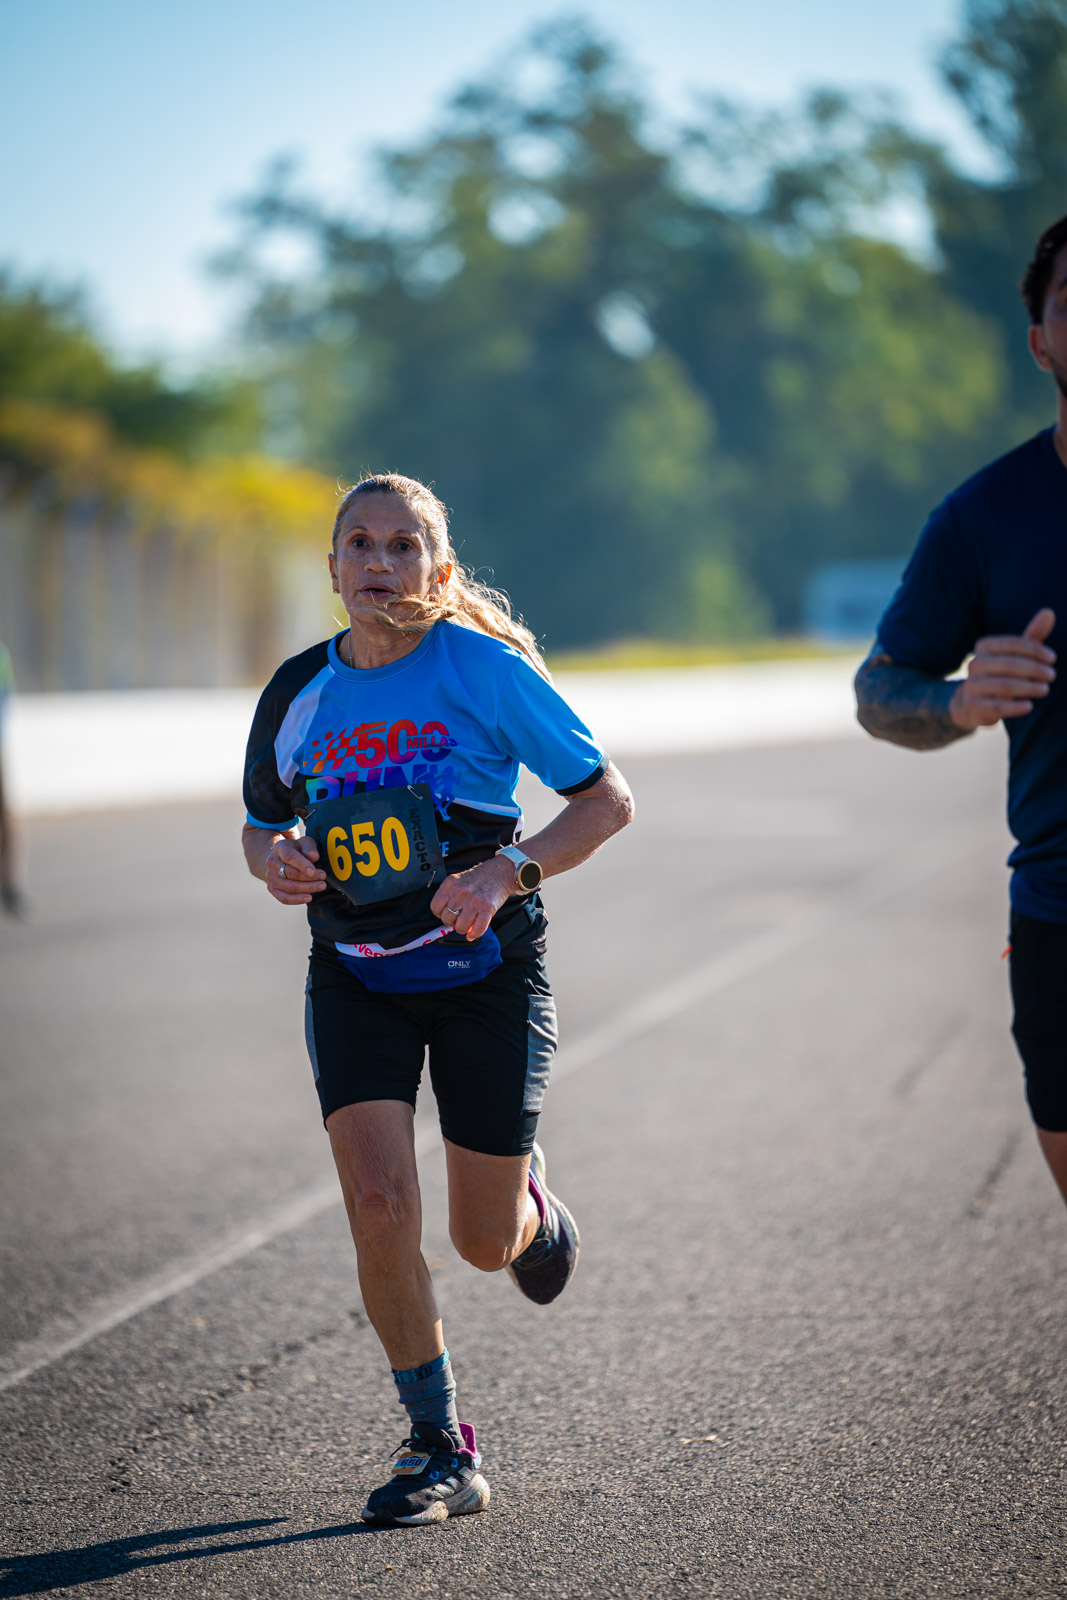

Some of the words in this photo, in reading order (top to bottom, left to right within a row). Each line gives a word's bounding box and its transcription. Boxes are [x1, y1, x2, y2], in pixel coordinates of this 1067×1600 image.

[354, 719, 453, 769] 500
[406, 736, 458, 750] MILLAS
[326, 816, 410, 882] 650
[408, 808, 432, 872] EXACTO
[400, 1458, 423, 1467] 650
